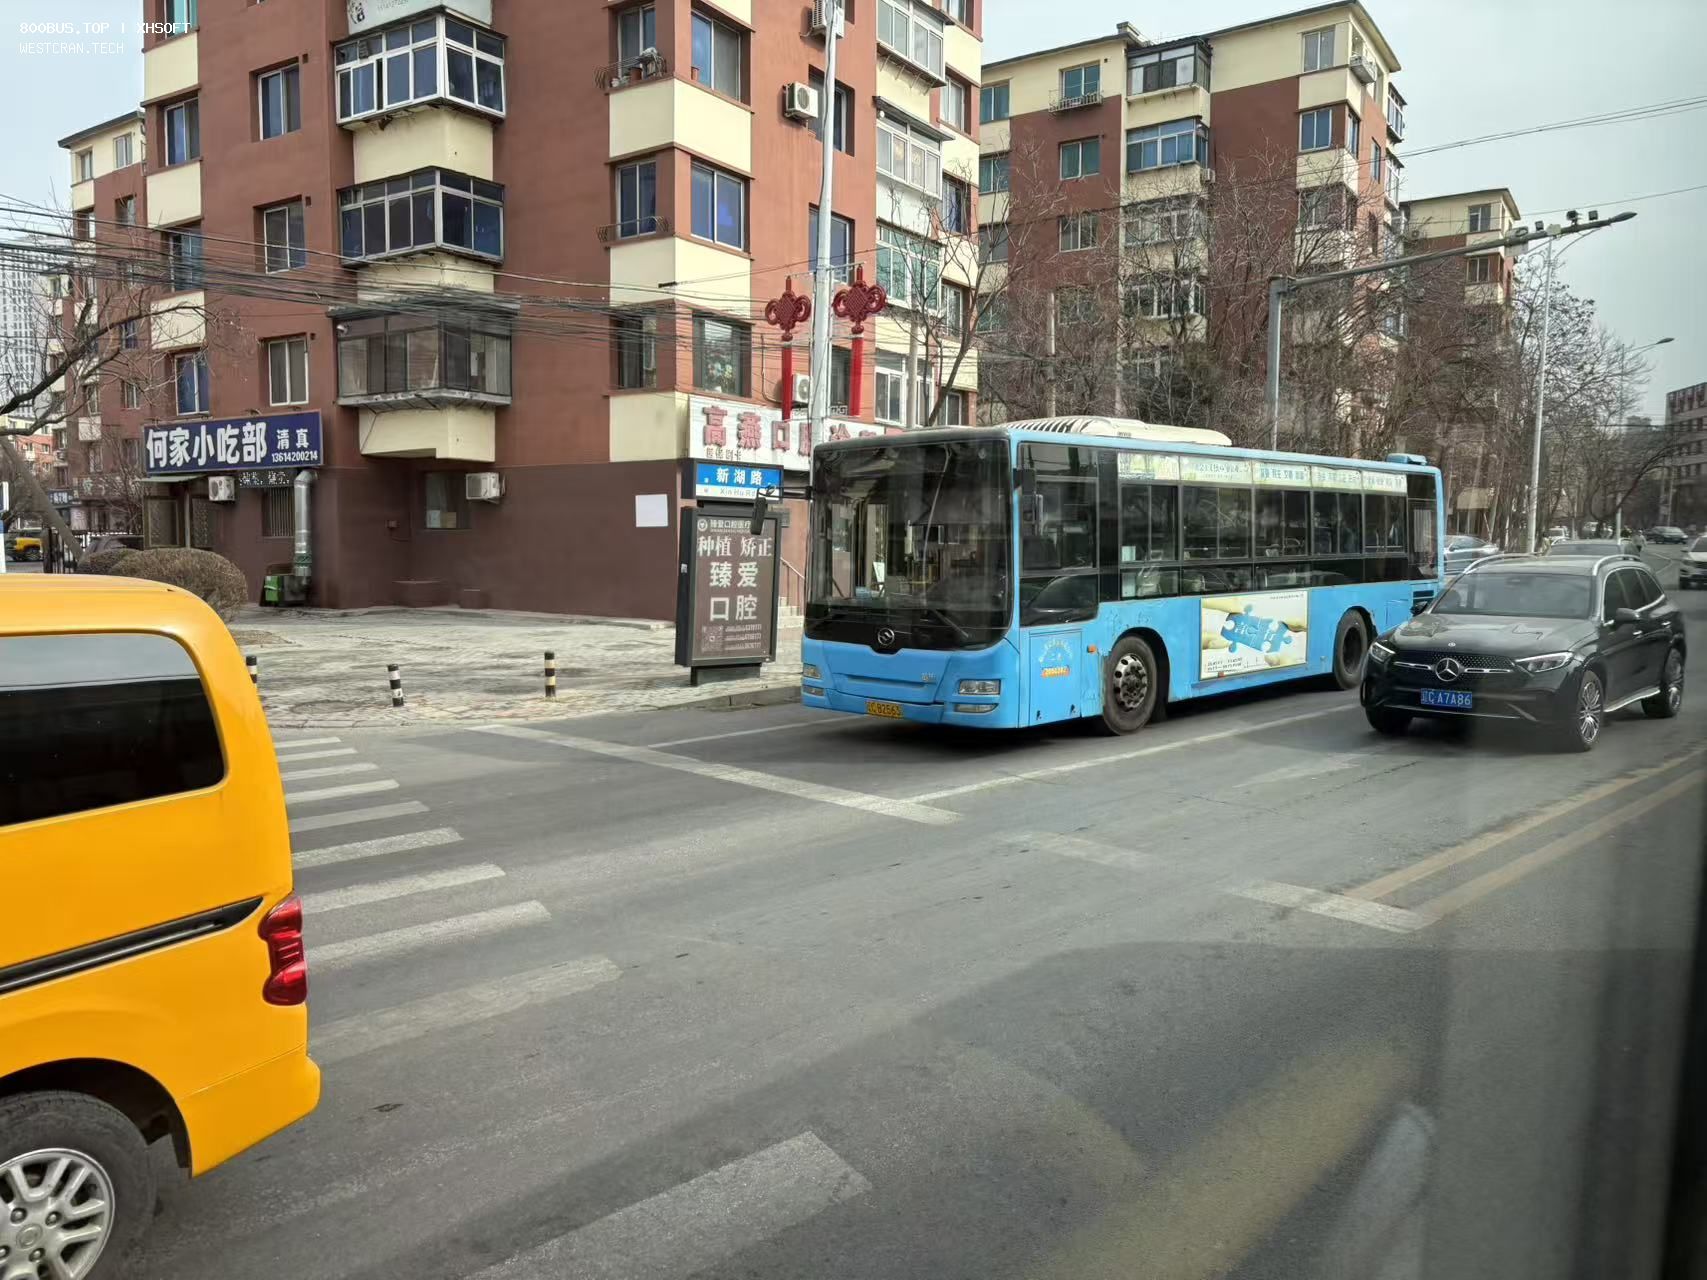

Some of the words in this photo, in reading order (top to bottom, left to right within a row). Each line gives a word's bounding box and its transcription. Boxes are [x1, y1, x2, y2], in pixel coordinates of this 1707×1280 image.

[146, 421, 268, 469] 何家小吃部
[276, 428, 309, 450] 清真
[271, 451, 318, 463] 13614200214
[716, 467, 763, 486] 新湖路
[720, 487, 732, 497] Xin
[697, 535, 732, 557] 种植
[740, 536, 772, 557] 矫正
[709, 561, 759, 588] 臻爱
[709, 596, 758, 621] 口腔
